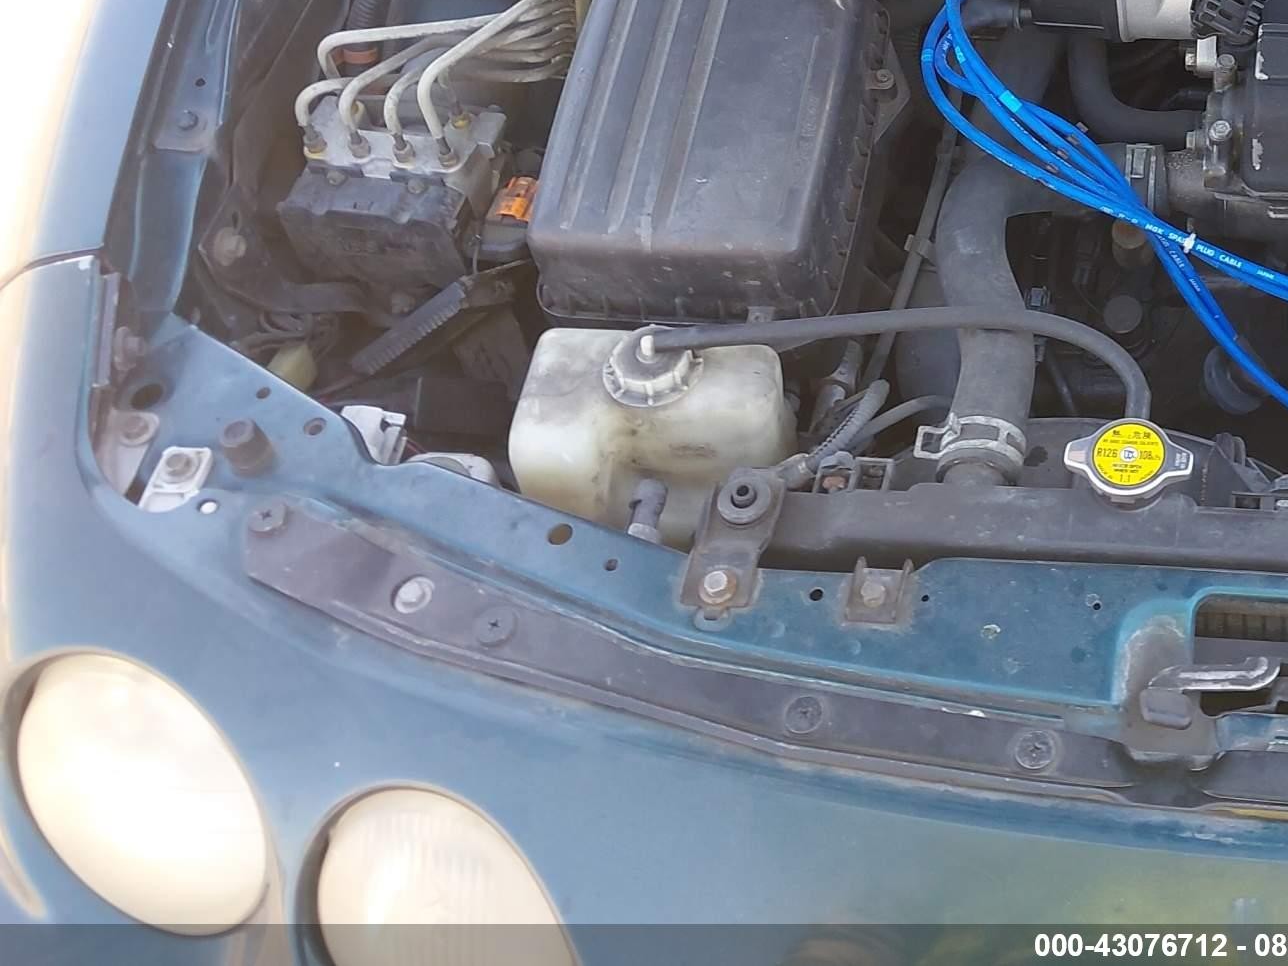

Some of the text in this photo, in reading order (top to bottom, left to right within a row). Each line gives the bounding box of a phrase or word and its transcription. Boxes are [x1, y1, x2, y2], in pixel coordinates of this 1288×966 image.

[1169, 250, 1185, 271] CABLE
[1195, 244, 1215, 257] PLUG
[1219, 254, 1243, 268] CABLE
[1096, 448, 1118, 457] R126
